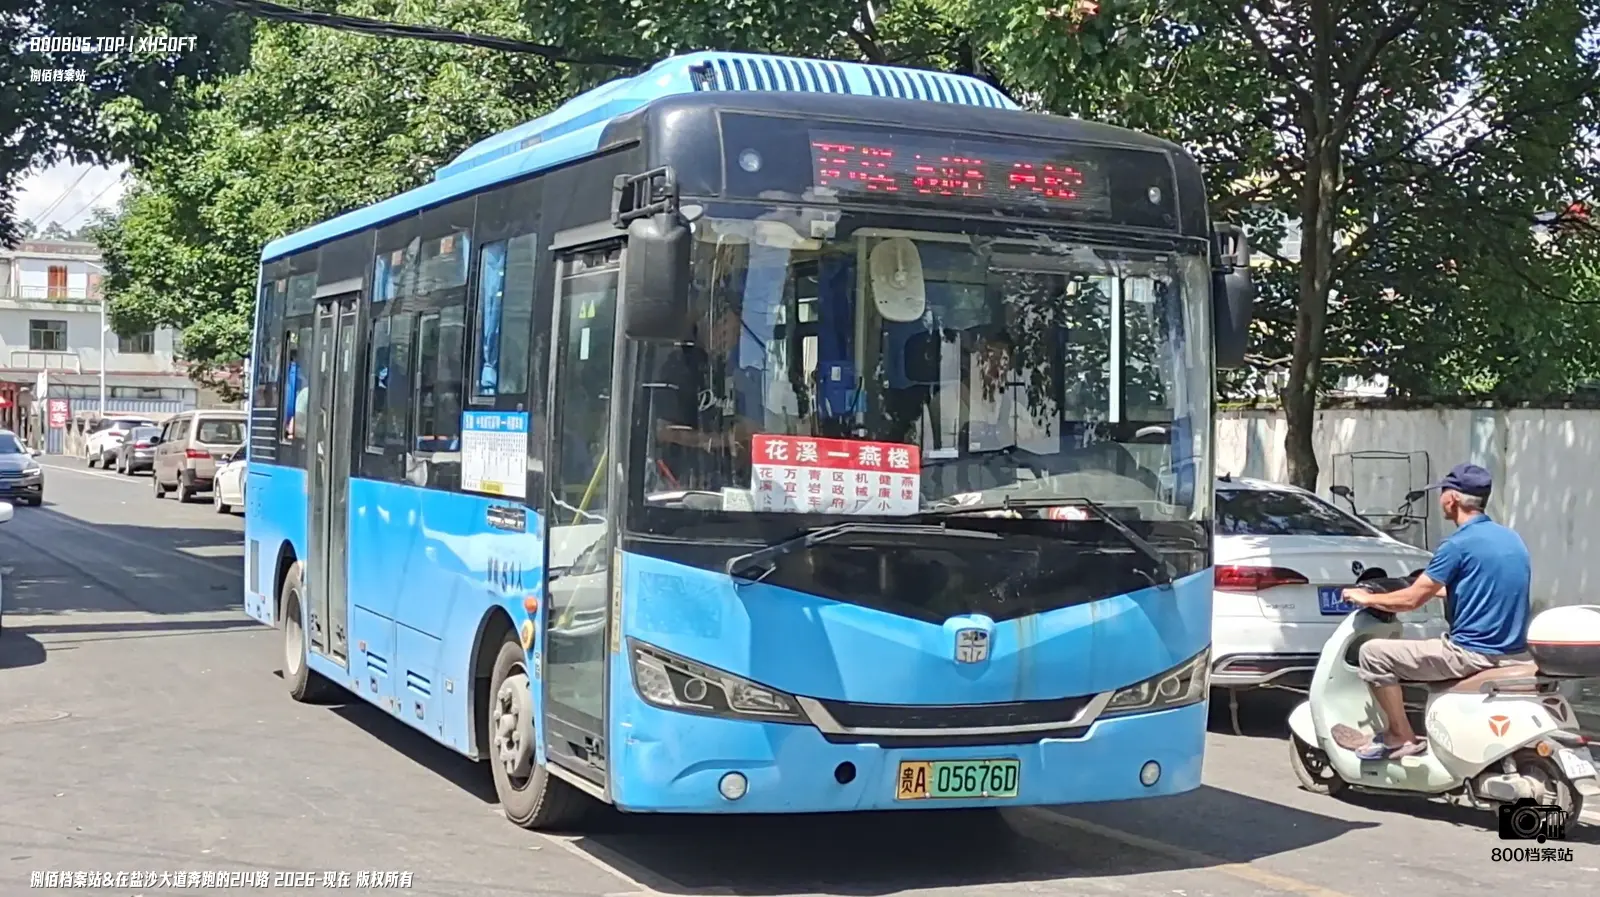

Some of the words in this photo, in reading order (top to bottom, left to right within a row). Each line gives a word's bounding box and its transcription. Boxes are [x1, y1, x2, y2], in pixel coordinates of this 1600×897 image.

[51, 401, 67, 424] 洗车
[832, 471, 844, 509] 区政府
[855, 472, 869, 509] 机械厂
[901, 476, 914, 500] 燕楼
